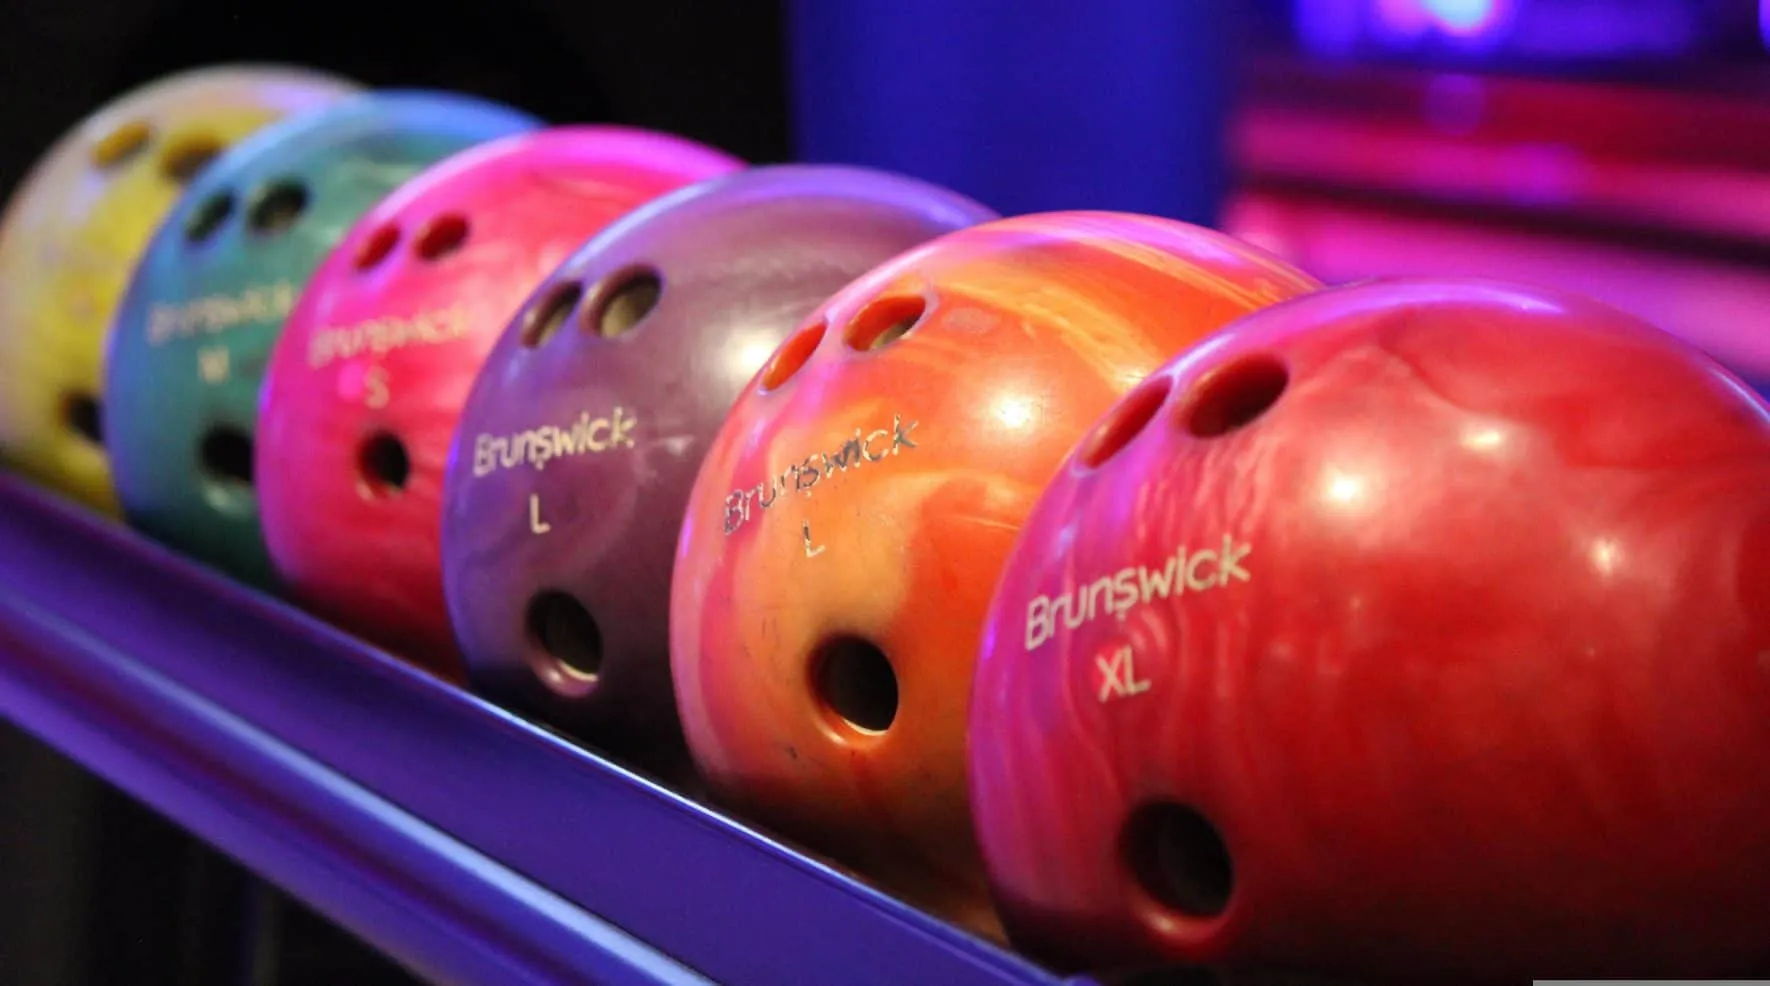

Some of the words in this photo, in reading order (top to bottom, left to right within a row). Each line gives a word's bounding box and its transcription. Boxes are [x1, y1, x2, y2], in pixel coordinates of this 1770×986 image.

[364, 365, 390, 408] S
[473, 407, 637, 476] Brunswick
[722, 414, 918, 536] Brunswick
[530, 494, 550, 533] L
[803, 519, 825, 558] L
[1025, 533, 1252, 651] Brunswick
[1095, 645, 1151, 703] XL
